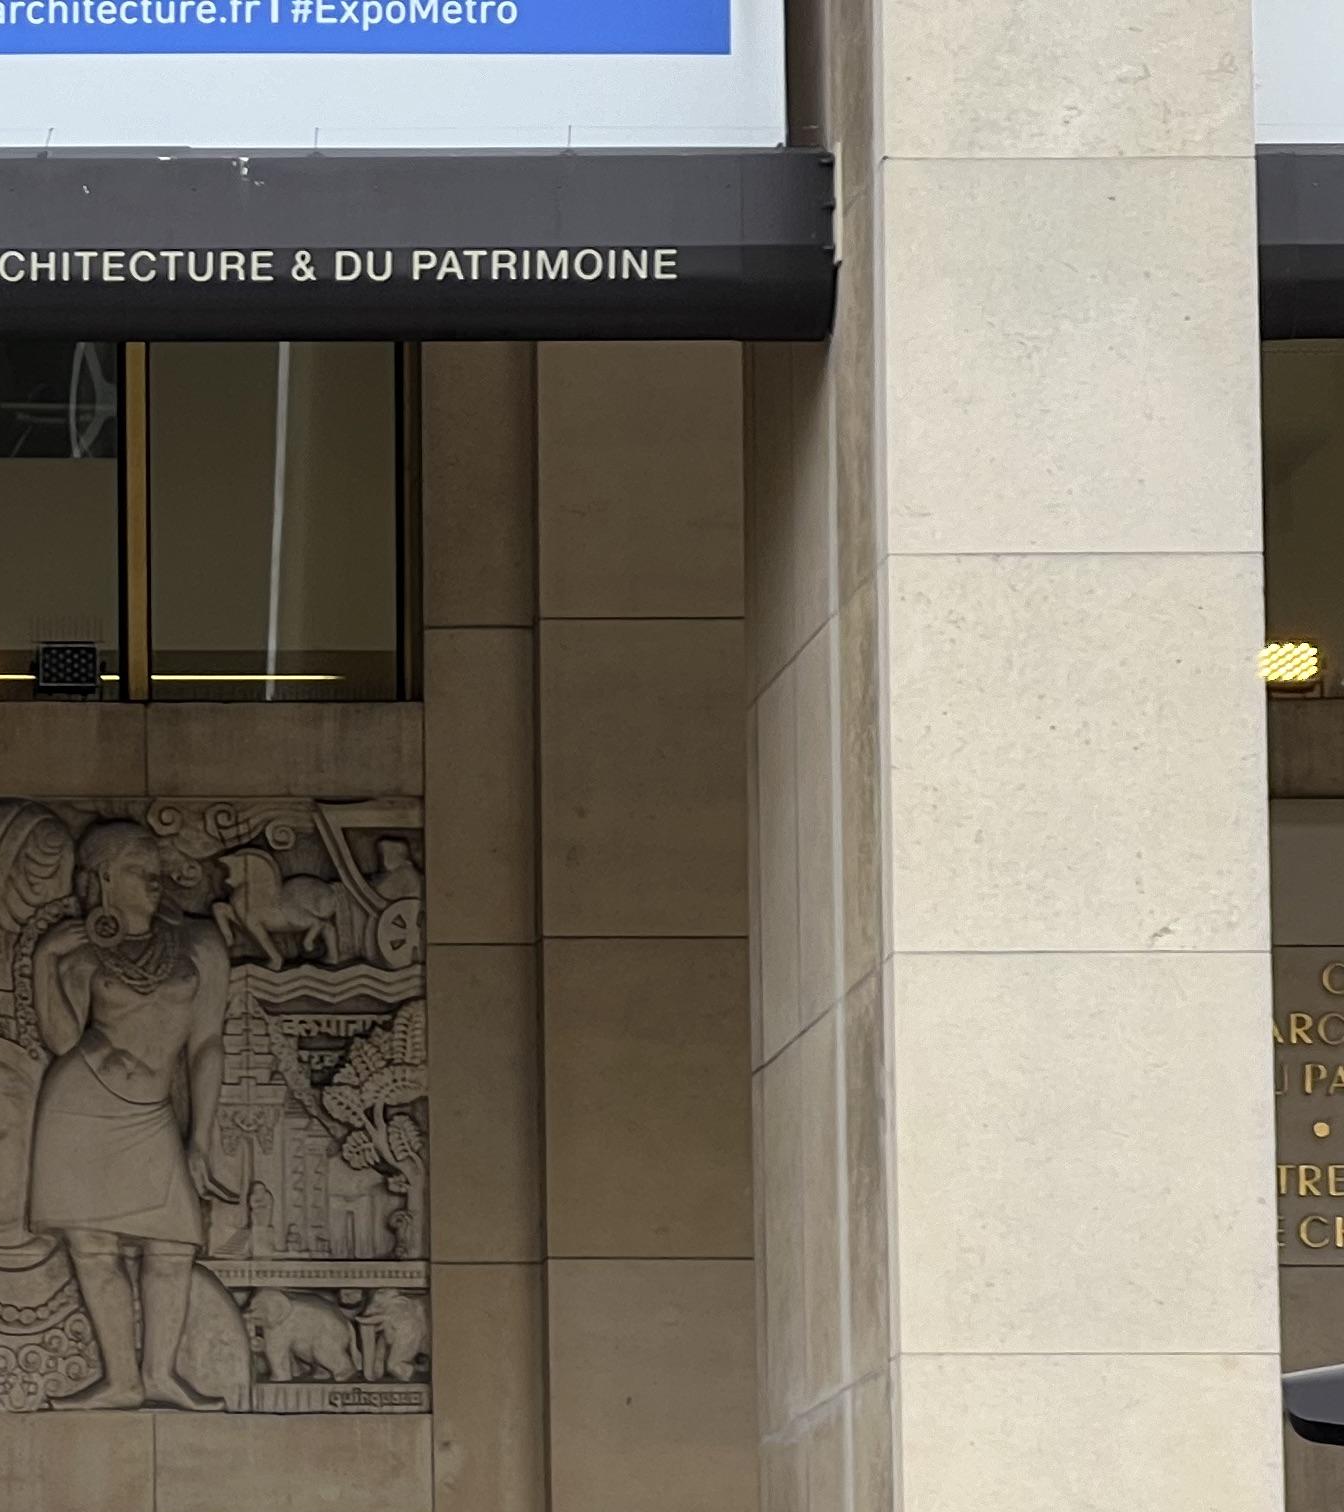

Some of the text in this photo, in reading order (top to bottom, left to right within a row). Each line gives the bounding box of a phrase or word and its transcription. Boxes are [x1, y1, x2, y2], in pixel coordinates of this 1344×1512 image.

[293, 249, 317, 282] &
[336, 250, 394, 282] DU
[412, 249, 678, 282] PATRIMOINE
